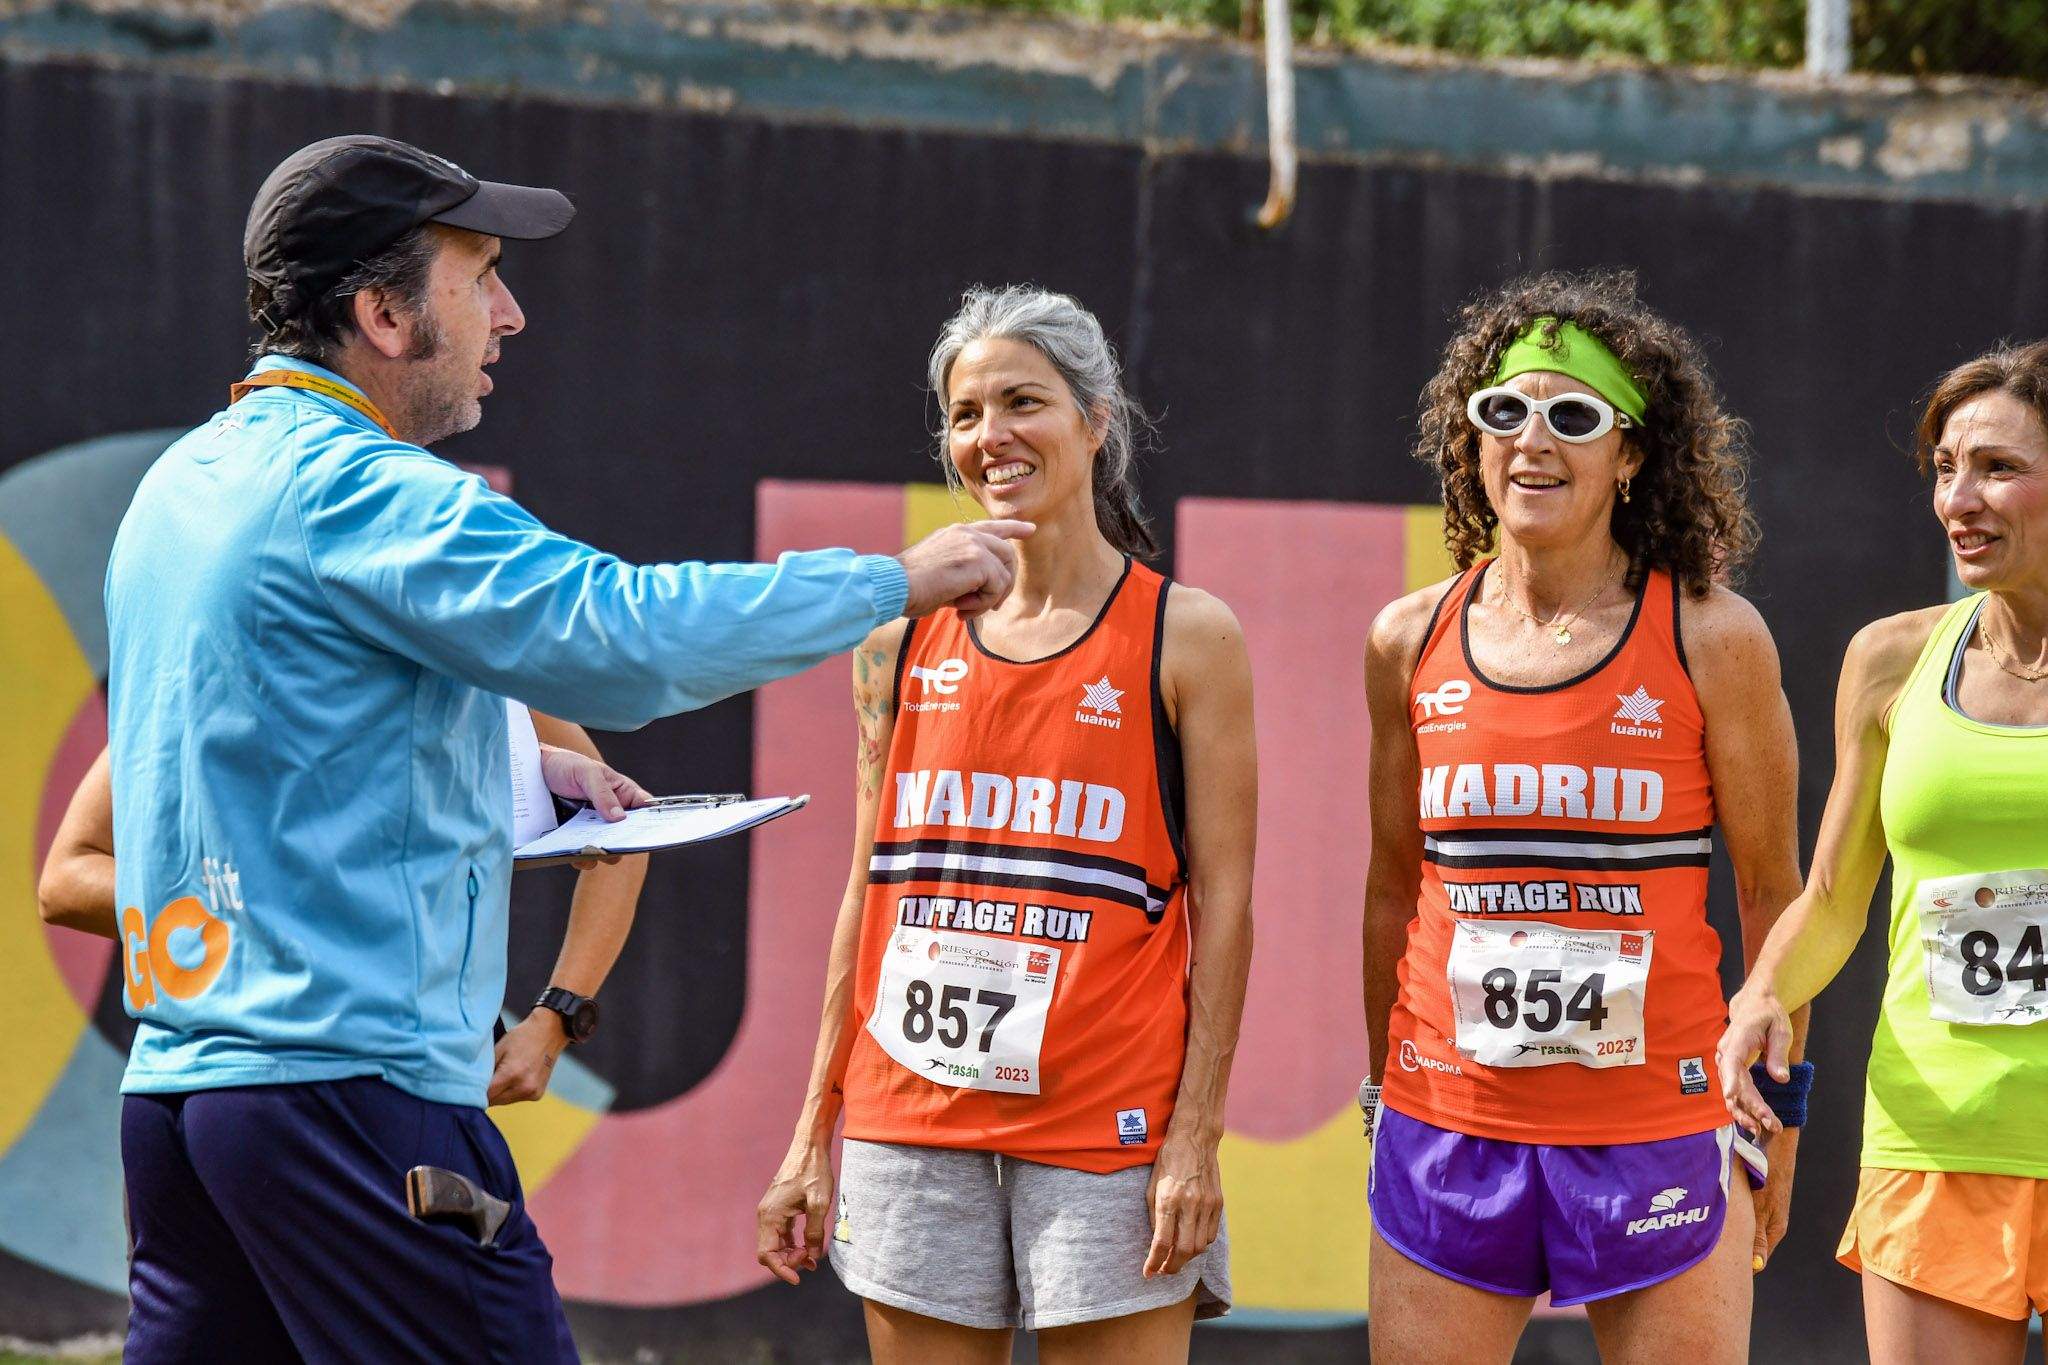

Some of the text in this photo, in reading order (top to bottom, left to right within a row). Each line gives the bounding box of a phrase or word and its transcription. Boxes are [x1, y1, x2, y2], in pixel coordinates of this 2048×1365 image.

[1074, 710, 1121, 730] luanvi
[1610, 722, 1662, 740] luanvi
[1420, 763, 1664, 822] MADRID
[202, 856, 244, 911] fit
[1577, 883, 1644, 916] RUN
[1021, 904, 1093, 943] RUN
[122, 895, 231, 1011] GO
[941, 944, 990, 958] RIESGO
[1482, 967, 1608, 1032] 854
[902, 979, 1017, 1053] 857
[1596, 1040, 1635, 1056] 2023
[948, 1063, 1029, 1082] rasán 2023
[1415, 1055, 1463, 1077] MAPOMA
[1626, 1206, 1710, 1236] KARHU
